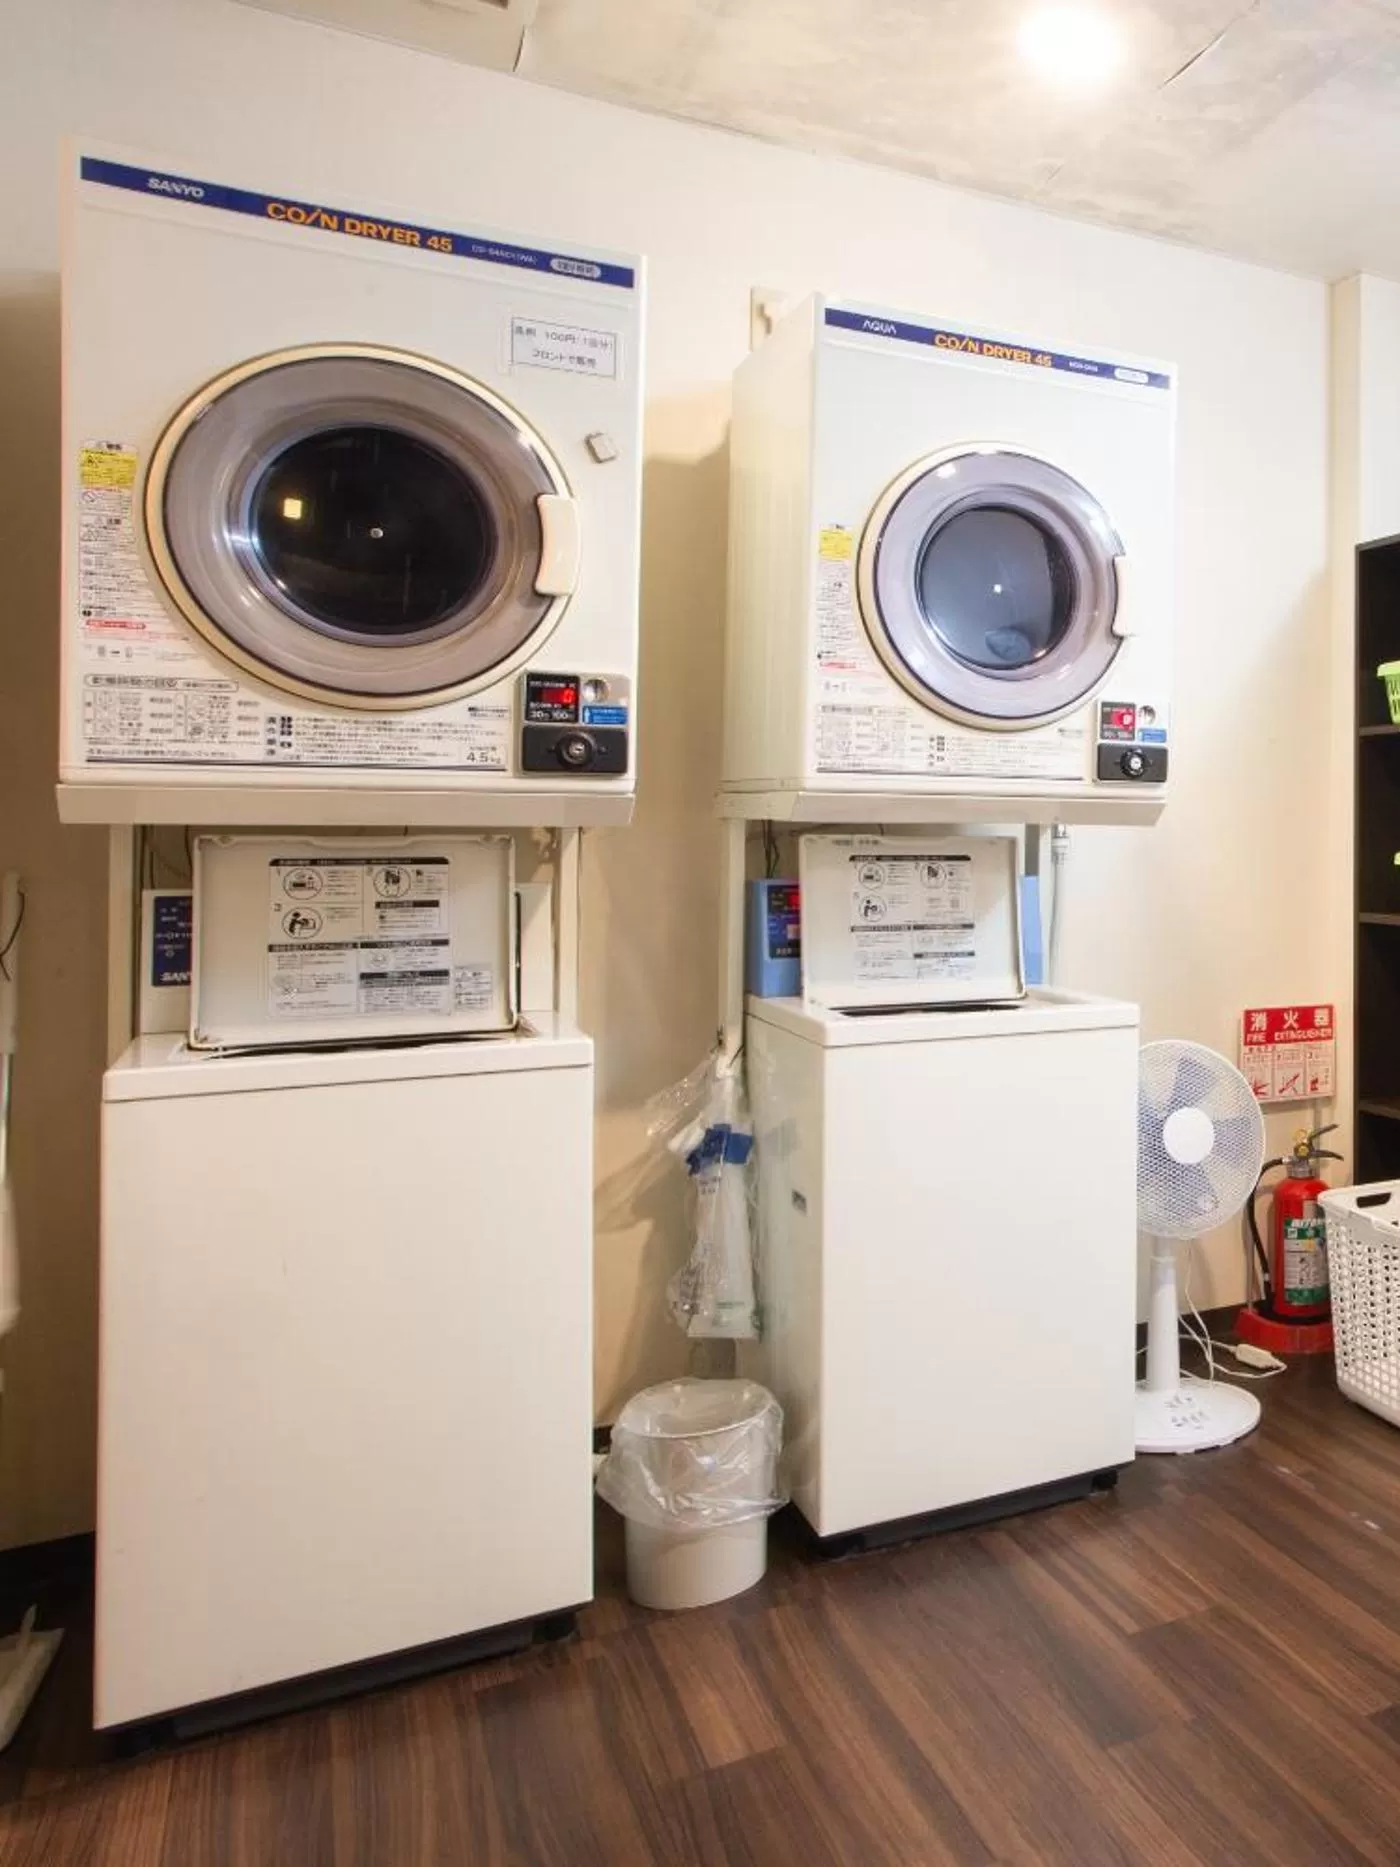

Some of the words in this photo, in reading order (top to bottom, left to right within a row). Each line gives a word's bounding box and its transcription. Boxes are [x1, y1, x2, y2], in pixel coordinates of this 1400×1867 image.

[147, 177, 205, 198] SANYO
[344, 217, 421, 248] DRYER
[426, 237, 453, 252] 45
[862, 319, 897, 335] AQUA
[982, 341, 1032, 363] DRYER
[1034, 354, 1053, 367] 45
[1246, 1032, 1267, 1043] FIRE
